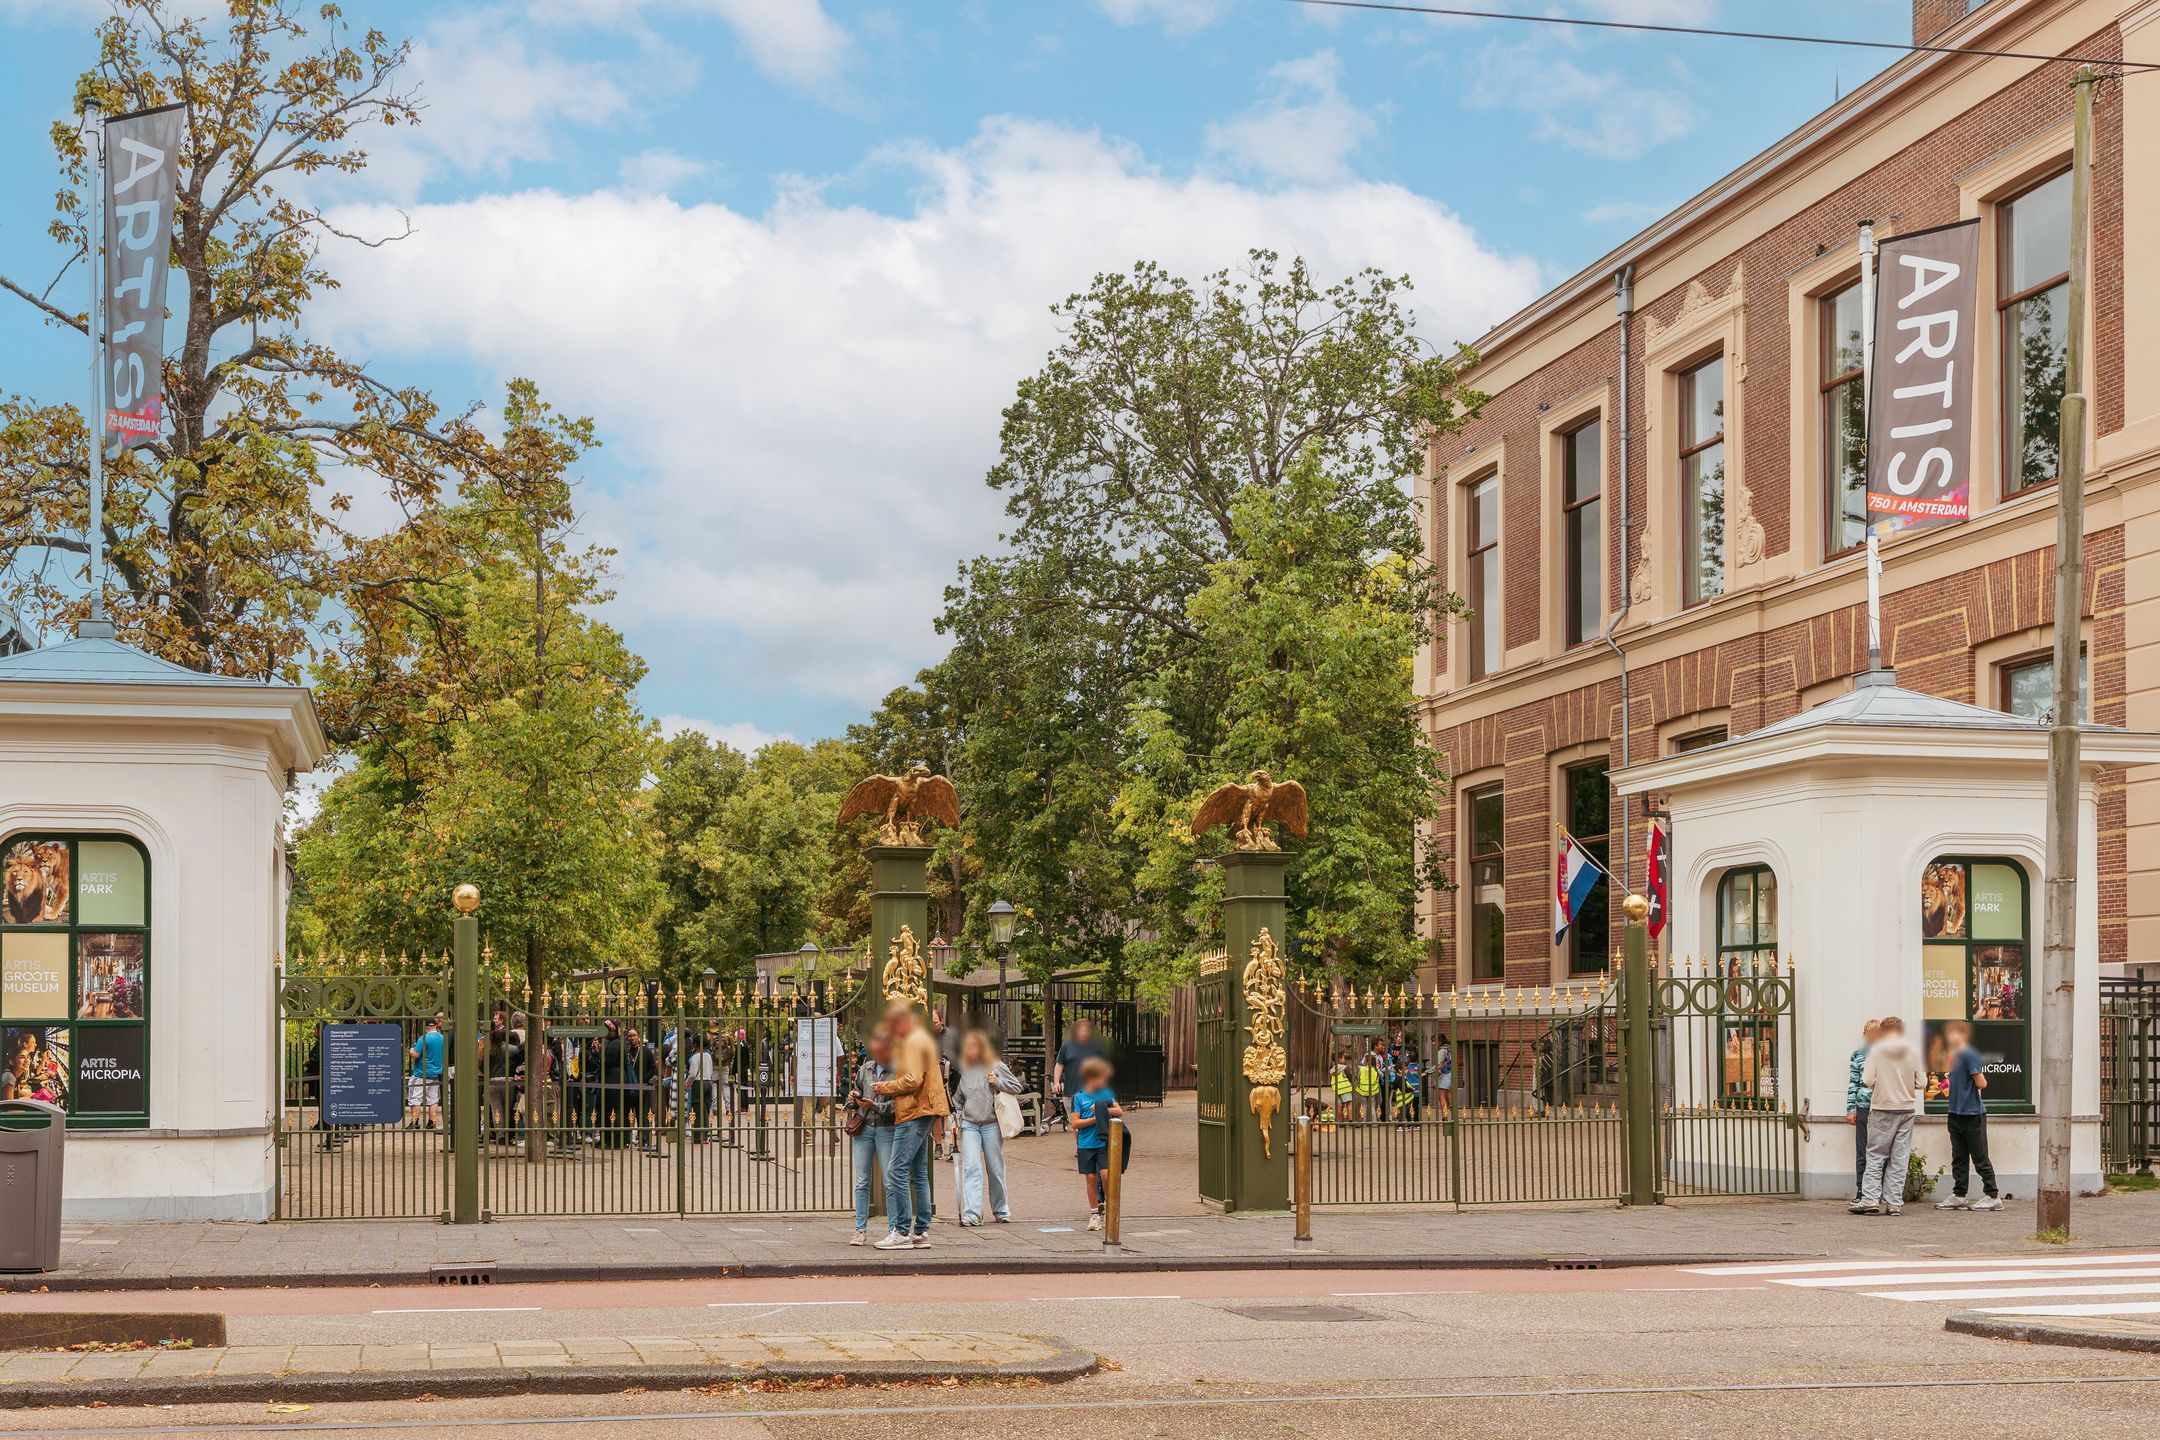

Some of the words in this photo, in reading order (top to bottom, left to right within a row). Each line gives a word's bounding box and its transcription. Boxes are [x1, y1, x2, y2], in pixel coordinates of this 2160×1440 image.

[113, 137, 165, 409] ARTIS
[1887, 254, 1960, 496] ARTIS
[1869, 495, 1891, 510] 750
[1898, 499, 1968, 517] AMSTERDAM
[81, 872, 118, 883] ARTIS
[81, 884, 113, 894] PARK
[1974, 892, 2003, 902] ARTIS
[1974, 903, 2000, 912] PARK
[4, 960, 41, 970] ARTIS
[4, 971, 58, 981] GROOTE
[1922, 969, 1945, 978] RTIS
[4, 983, 59, 993] MUSEUM
[81, 1057, 117, 1068] ARTIS
[81, 1069, 141, 1080] MICROPIA
